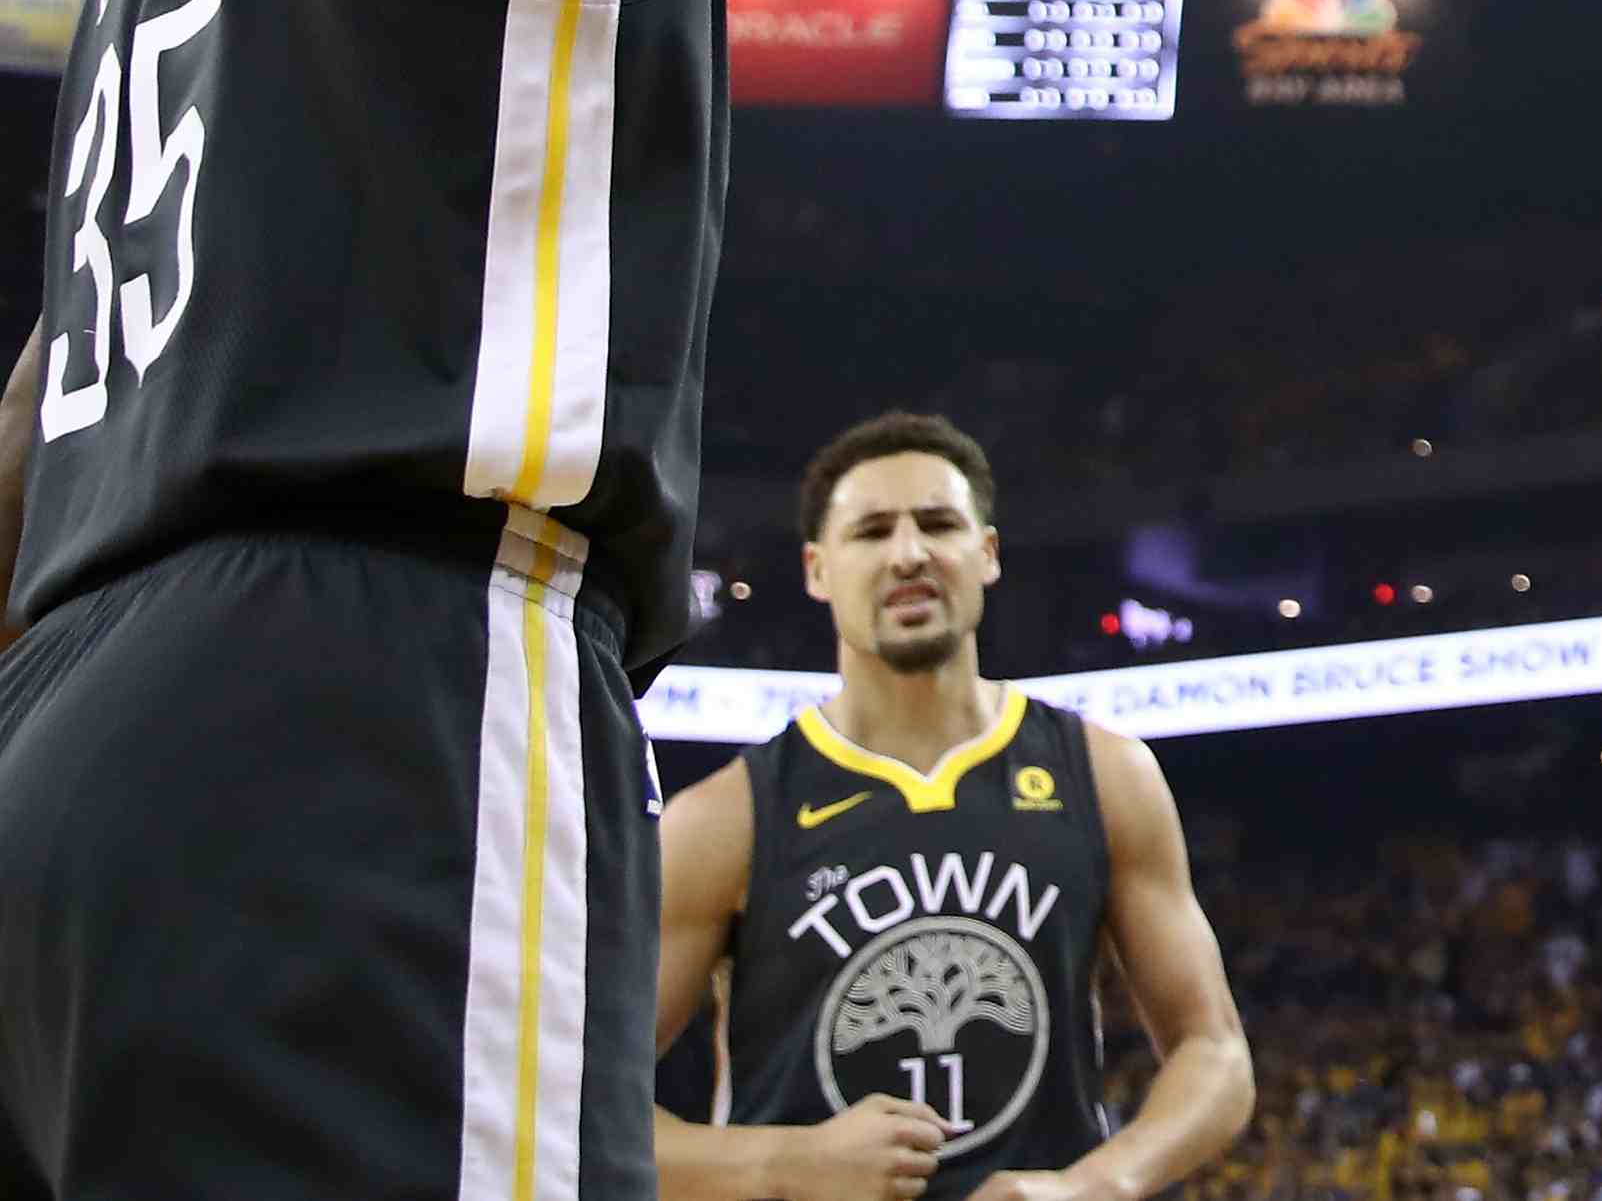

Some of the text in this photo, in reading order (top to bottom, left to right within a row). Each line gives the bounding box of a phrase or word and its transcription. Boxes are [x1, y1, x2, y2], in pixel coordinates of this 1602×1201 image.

[1112, 674, 1271, 716] DAMON
[1293, 655, 1434, 696] BRUCE
[1460, 639, 1592, 679] SHOW
[787, 851, 1062, 959] TOWN
[898, 1053, 975, 1133] 11
